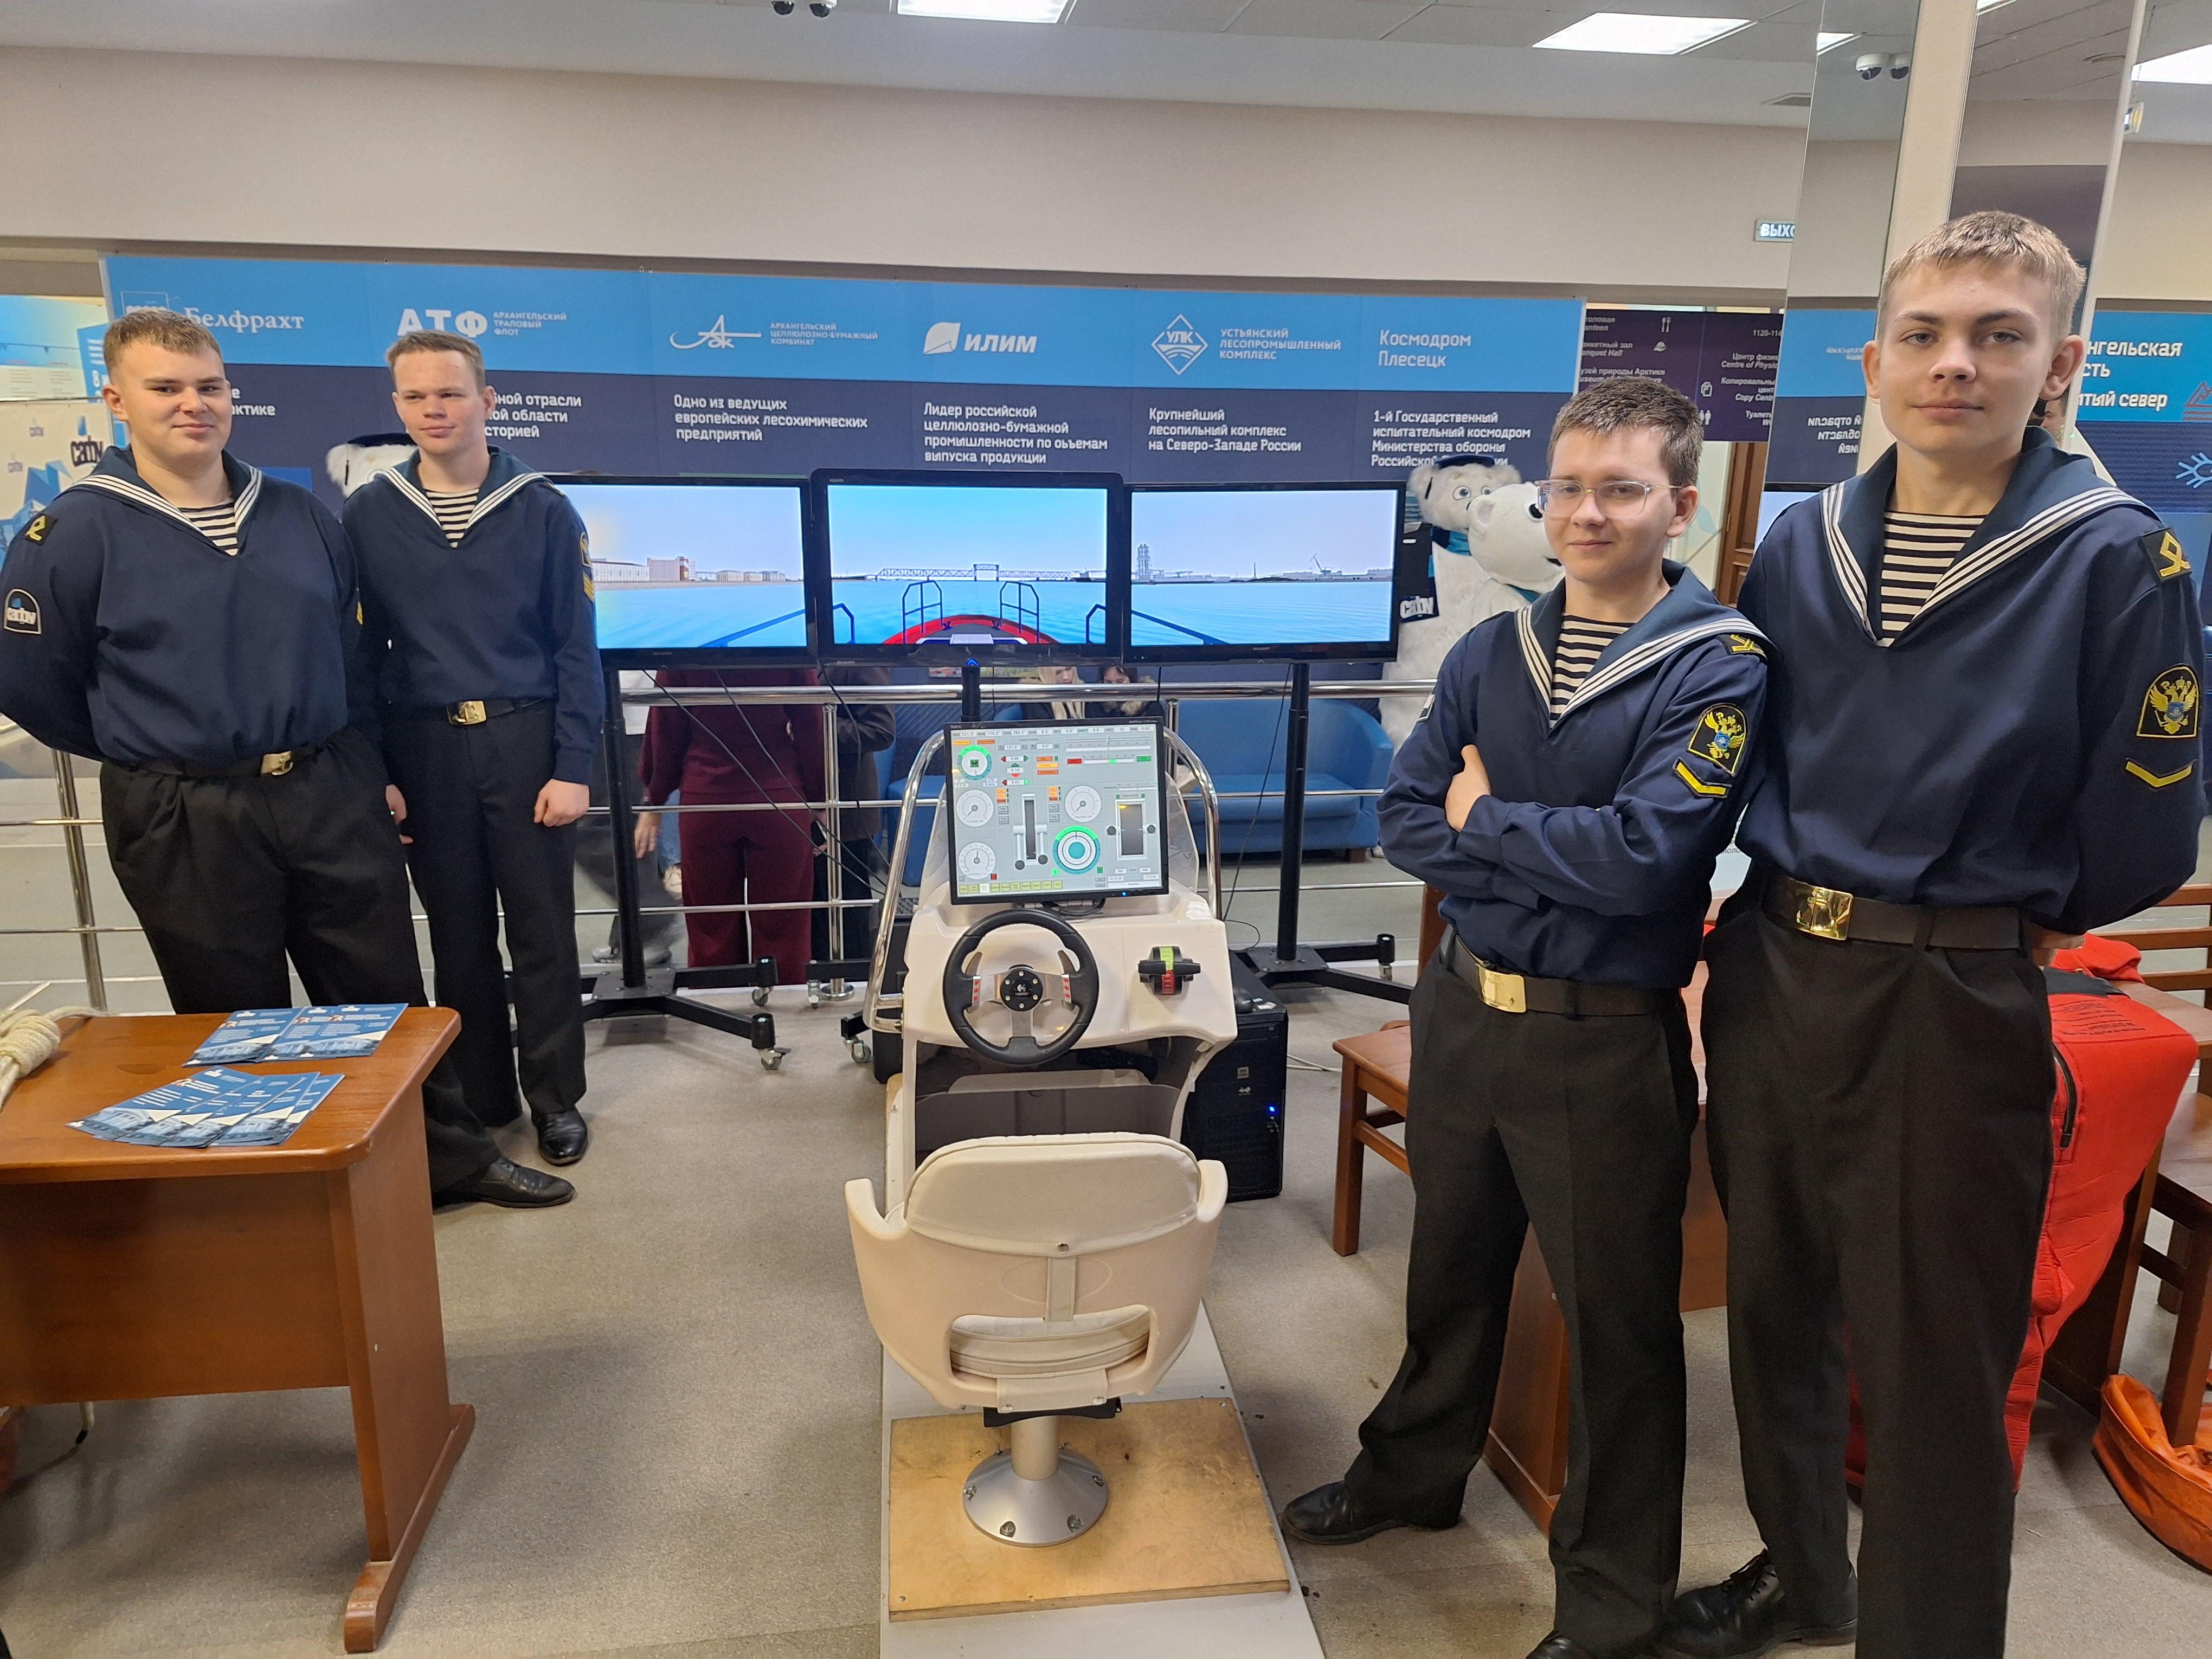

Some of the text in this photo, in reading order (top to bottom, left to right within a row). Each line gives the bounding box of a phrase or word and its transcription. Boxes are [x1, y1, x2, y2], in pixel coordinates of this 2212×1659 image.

[183, 307, 304, 333] Белфрахт
[397, 308, 487, 338] АТФ
[493, 311, 567, 321] АРХАНГЕЛЬСКИЙ
[493, 319, 542, 328] ТРАЛОВЫЙ
[770, 322, 837, 331] АРХАНГЕЛЬСКИЙ
[770, 331, 878, 340] ЦЕЛЛЮЛОЗНО-БУМАЖНЫЙ
[1166, 331, 1193, 344] УЛК
[1220, 328, 1289, 338] УСТЬЯНСКИЙ
[1379, 329, 1471, 350] Космодром
[963, 334, 1038, 353] ИЛИМ
[1219, 339, 1341, 350] ЛЕСОПРОМЫШЛЕННЫЙ
[2086, 340, 2183, 357] нгельская
[1219, 350, 1277, 360] КОМПЛЕКС
[1378, 350, 1446, 368] Плесецк
[1732, 353, 1754, 361] Центр
[1580, 367, 1597, 375] узей
[525, 395, 582, 409] отрасли
[674, 394, 787, 411] Одно из ведущих
[1735, 394, 1754, 402] Copy
[2118, 394, 2168, 411] север
[512, 408, 568, 422] области
[923, 403, 1037, 419] Лидер российской
[1148, 408, 1225, 423] Крупнейший
[1373, 410, 1499, 425] 1-й Государственный
[674, 412, 868, 428] европейских лесохимических
[484, 425, 540, 440] сторией
[924, 421, 1069, 434] целлюлозно-бумажной
[1148, 424, 1287, 436] лесопильный комплекс
[1373, 426, 1531, 439] испытательный космодром
[676, 427, 763, 443] предприятий
[924, 436, 1034, 449] промышленности
[1037, 438, 1051, 448] по
[1148, 438, 1302, 453] на Северо-Западе России
[1372, 440, 1506, 454] Министерства обороны
[924, 451, 1046, 465] выпуска продукции
